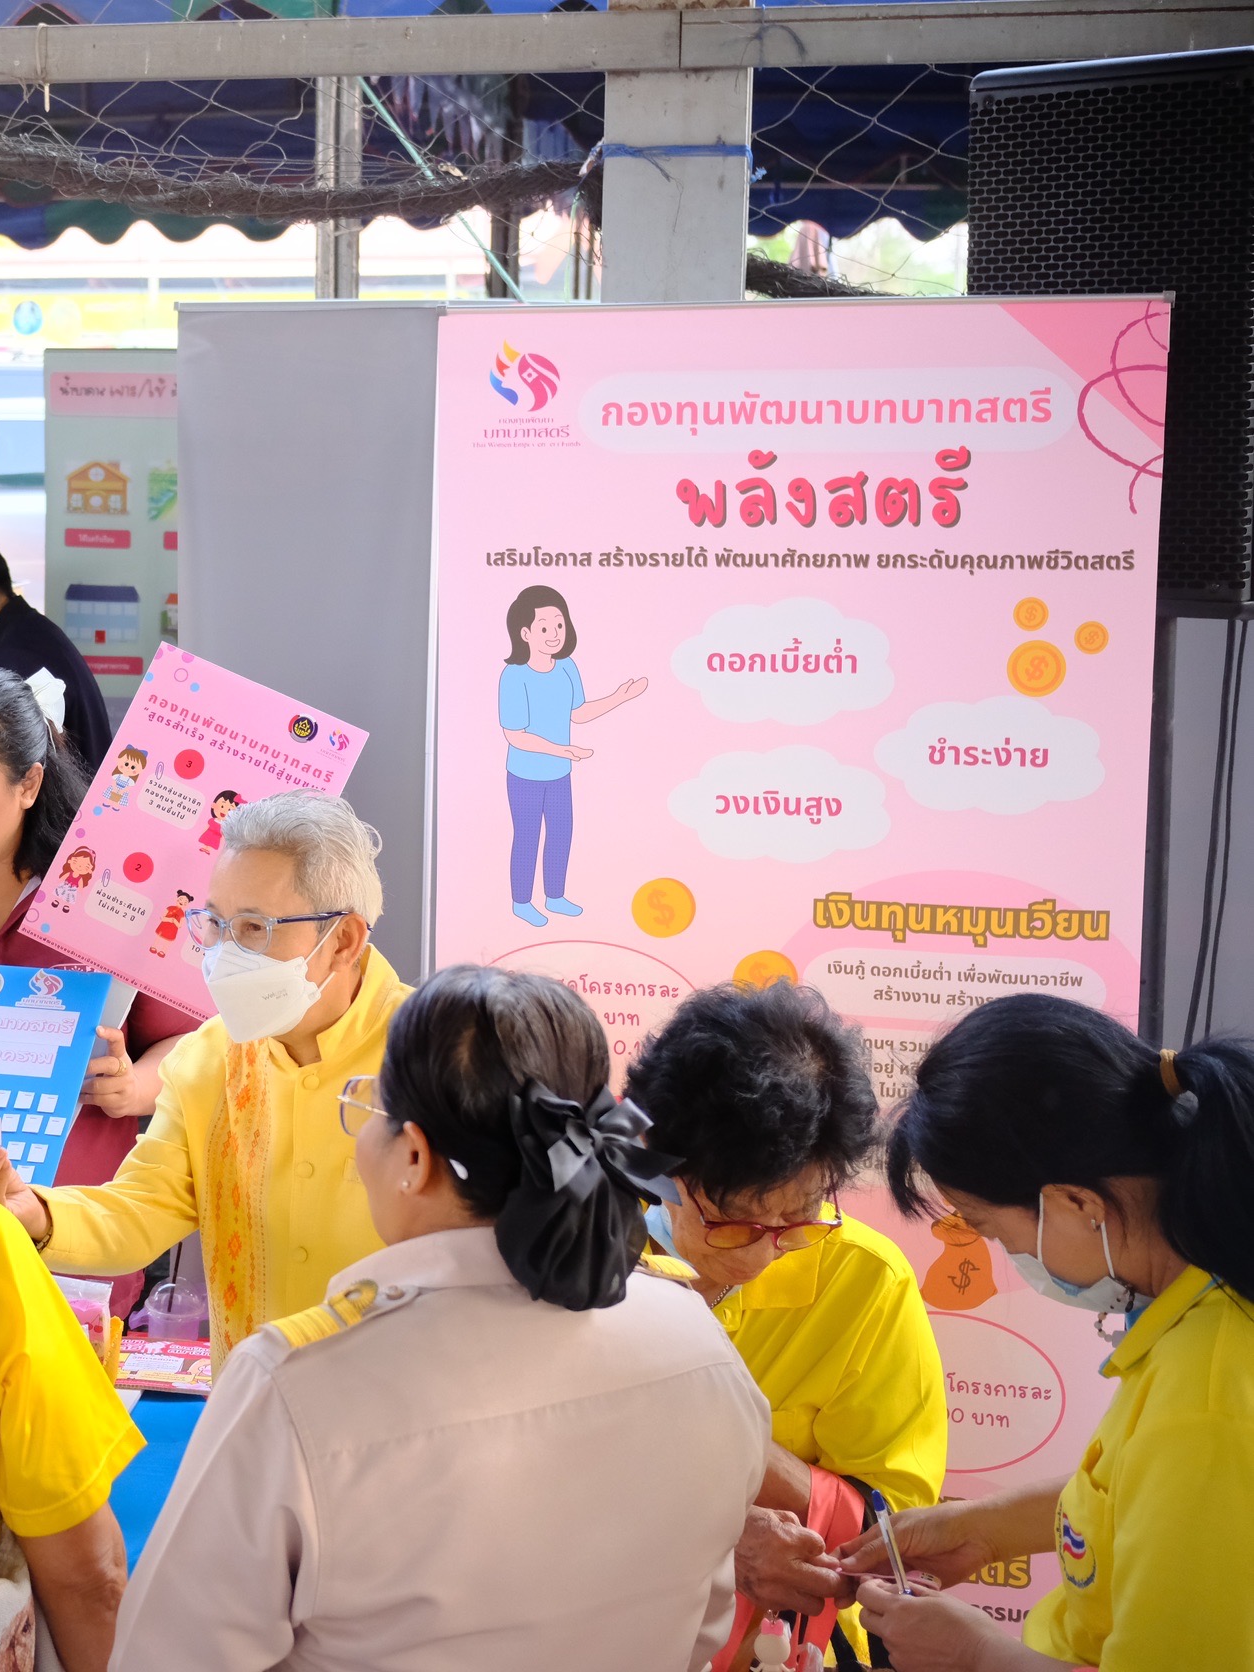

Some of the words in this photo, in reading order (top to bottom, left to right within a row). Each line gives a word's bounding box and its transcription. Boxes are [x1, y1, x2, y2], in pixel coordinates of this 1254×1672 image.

[601, 386, 1053, 437] กองทุนพัฒนาบทบาทสตรี
[483, 425, 570, 439] บทบาทสตรี
[676, 445, 973, 529] พลังสตรี
[485, 546, 593, 570] เสริมโอกาส
[598, 546, 708, 570] สร้างรายได้
[714, 549, 870, 571] พัฒนาศักยภาพ
[876, 548, 1136, 577] ยกระดับคุณภาพชีวิตสตรี
[706, 636, 859, 676] ดอกเบี้ยต่ำ
[147, 692, 335, 784] กองทุนพัฒนาบทบาทสตรี
[927, 734, 1049, 770] ชำระง่าย
[715, 791, 843, 825] วงเงินสูง
[813, 891, 1111, 948] เงินทุนหมุนเวียน
[827, 960, 865, 980] เงินกู้
[870, 960, 952, 982] ดอกเบี้ยต่ำ
[957, 963, 1083, 987] เพื่อพัฒนาอาชีพ
[873, 986, 941, 1005] สร้างงาน
[603, 1012, 640, 1026] บาท
[972, 1409, 1010, 1429] บาท
